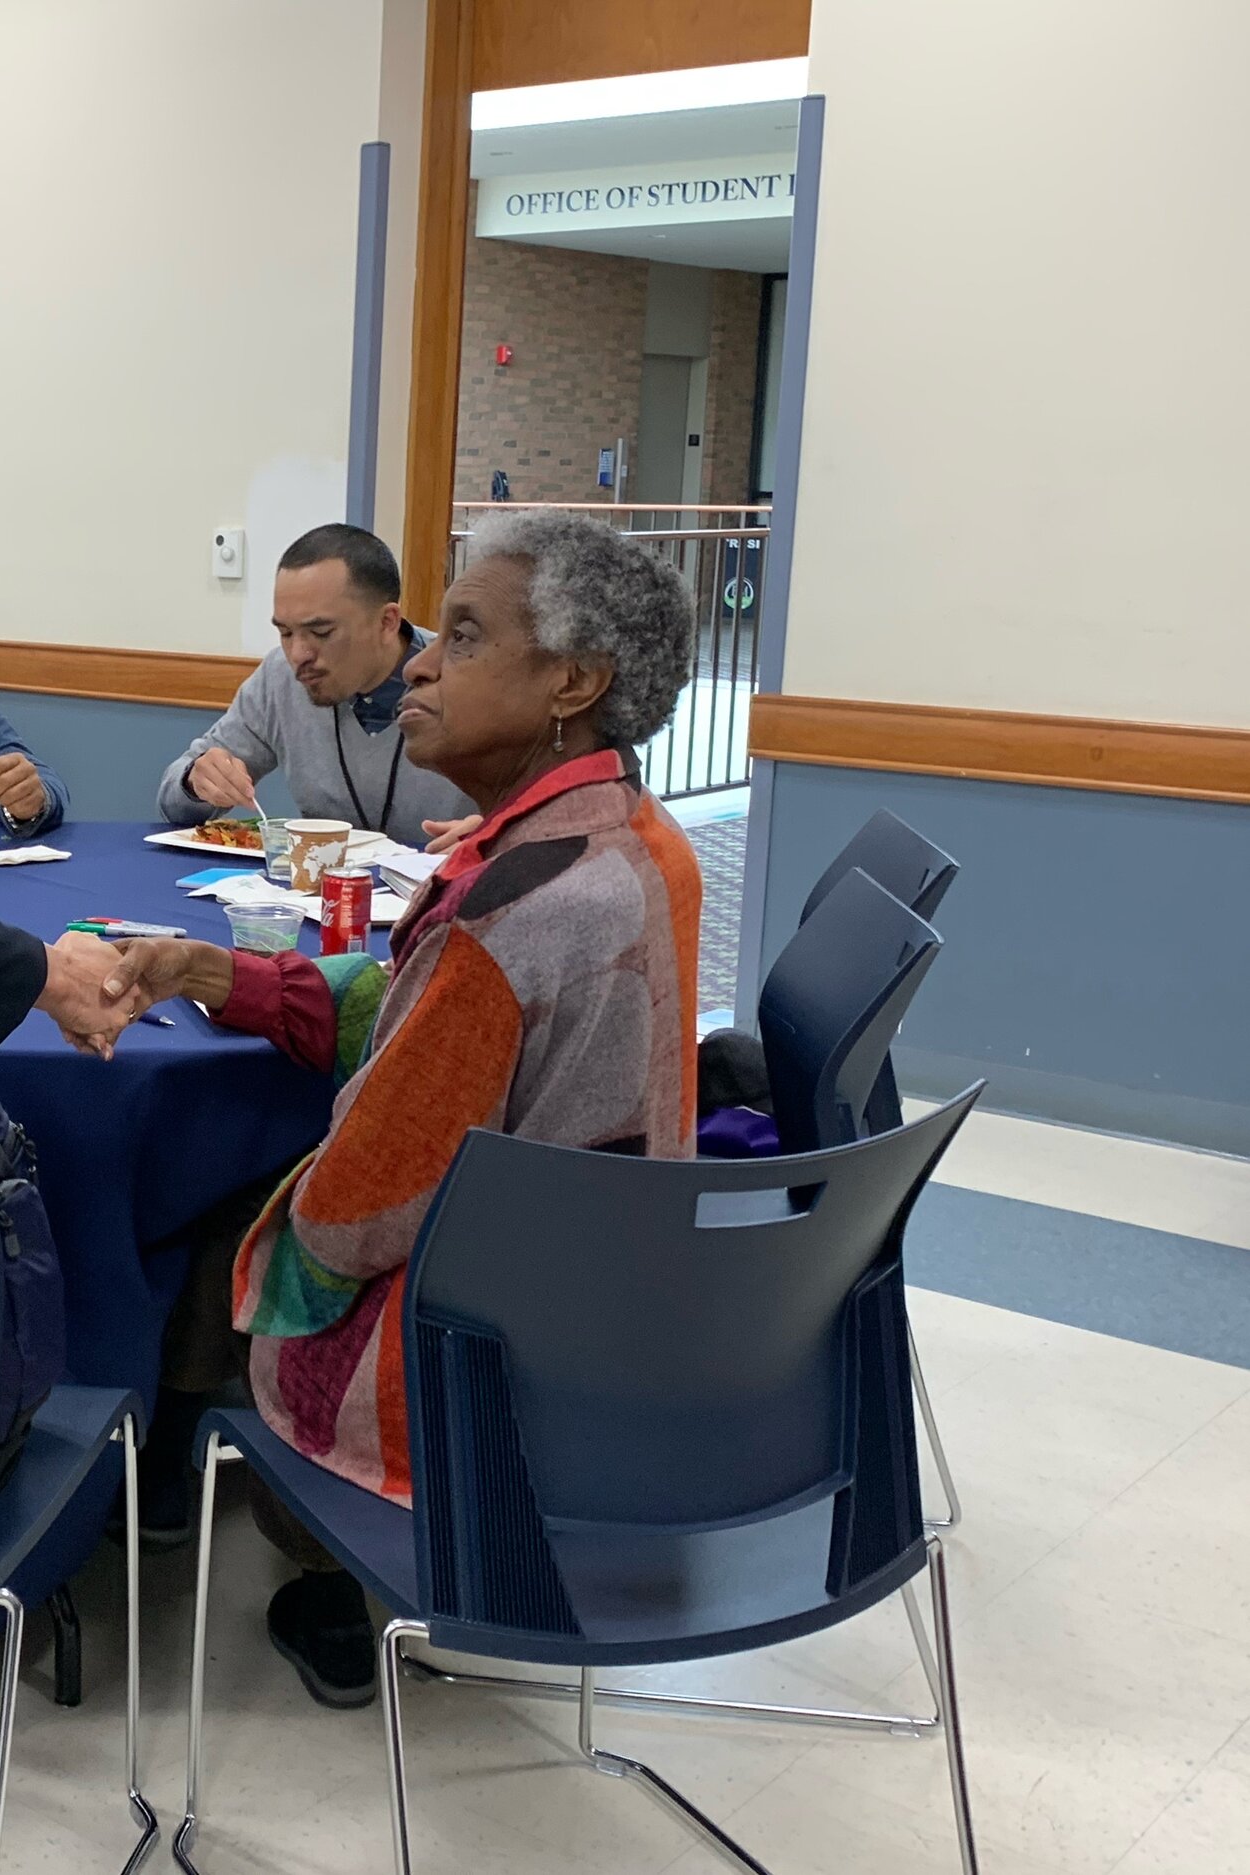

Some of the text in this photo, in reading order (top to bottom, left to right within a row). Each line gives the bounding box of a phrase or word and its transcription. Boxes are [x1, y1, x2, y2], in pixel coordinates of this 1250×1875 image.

[506, 188, 599, 216] OFFICE
[605, 186, 643, 209] OF
[646, 174, 782, 208] STUDENT
